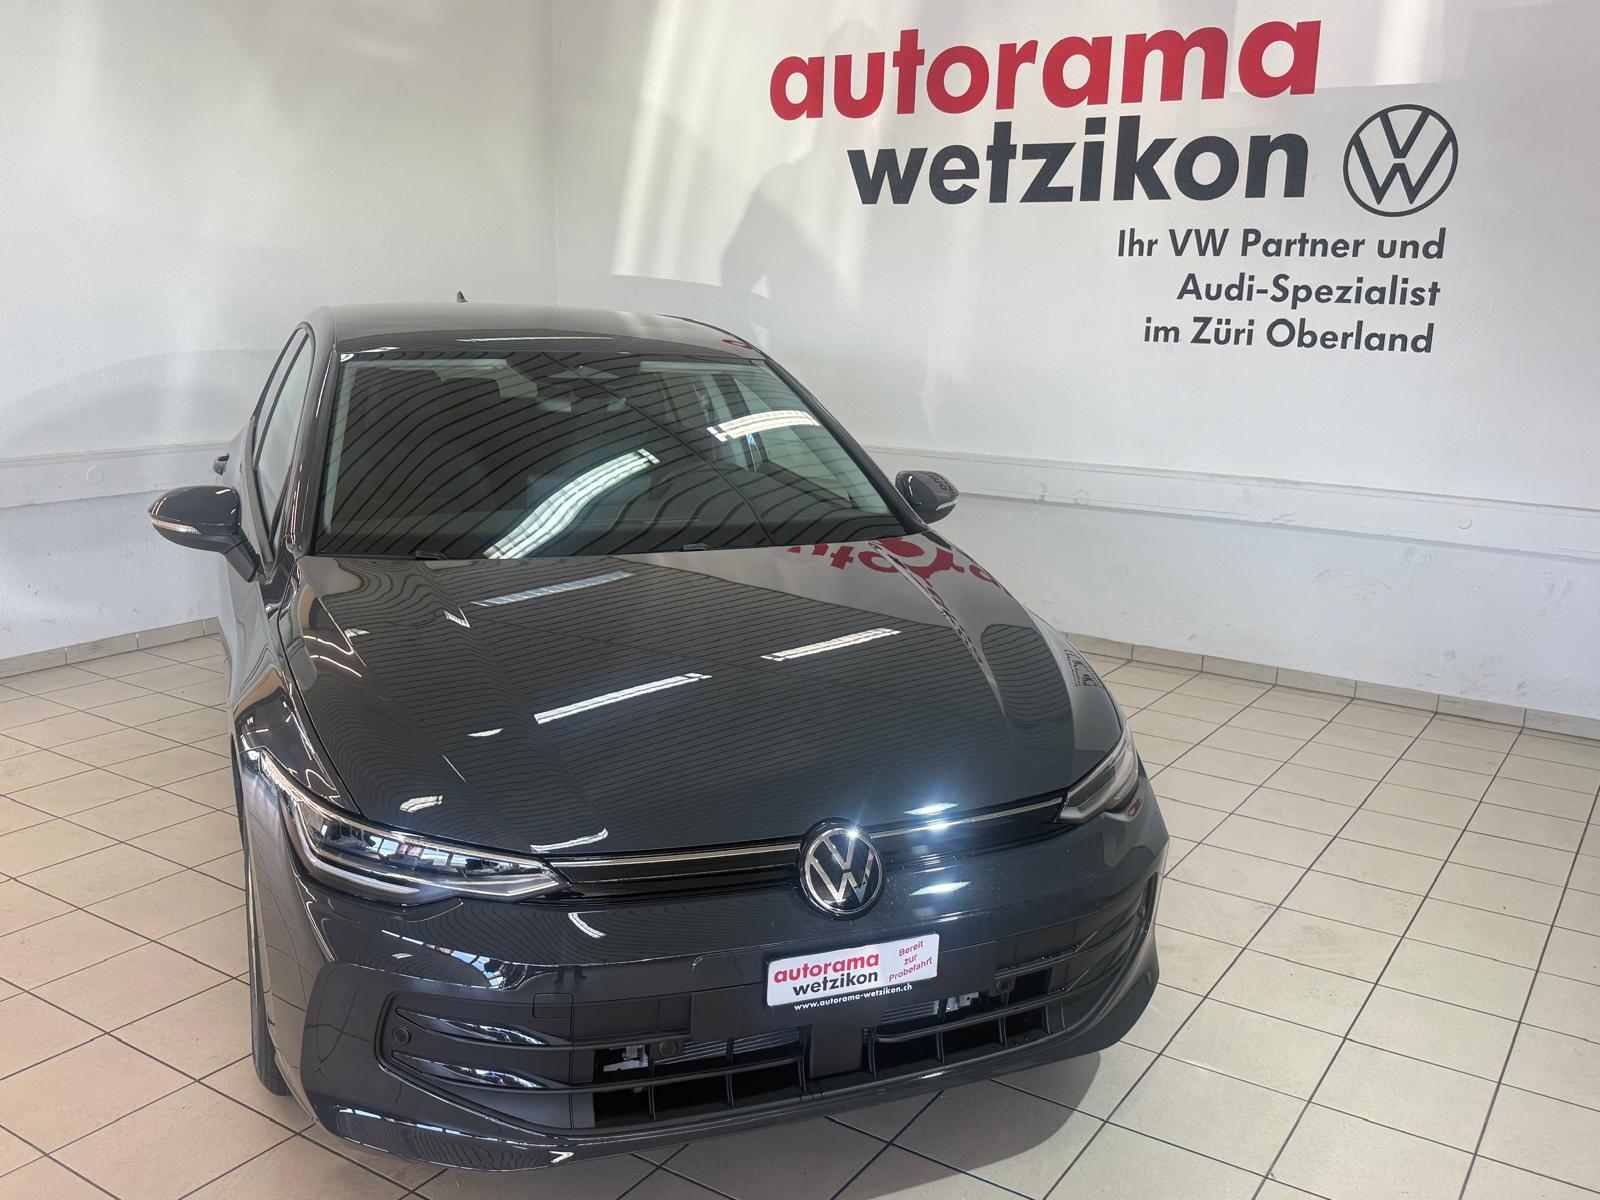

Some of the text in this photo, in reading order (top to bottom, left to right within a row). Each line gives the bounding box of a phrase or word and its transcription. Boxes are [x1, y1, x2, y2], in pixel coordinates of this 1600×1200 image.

[770, 21, 1320, 120] autorama
[847, 116, 1308, 204] wetzikon
[1119, 228, 1446, 259] Ihr VW Partner und
[1177, 273, 1441, 309] Audi-Spezialist
[1144, 317, 1434, 352] im Züri Oberland
[898, 940, 924, 957] Bereit
[904, 953, 918, 966] zur
[774, 953, 880, 983] autorama
[888, 956, 934, 982] Probefahrt
[793, 971, 879, 996] wetzikon
[793, 982, 913, 1011] www.autorama-wetzikon.ch
